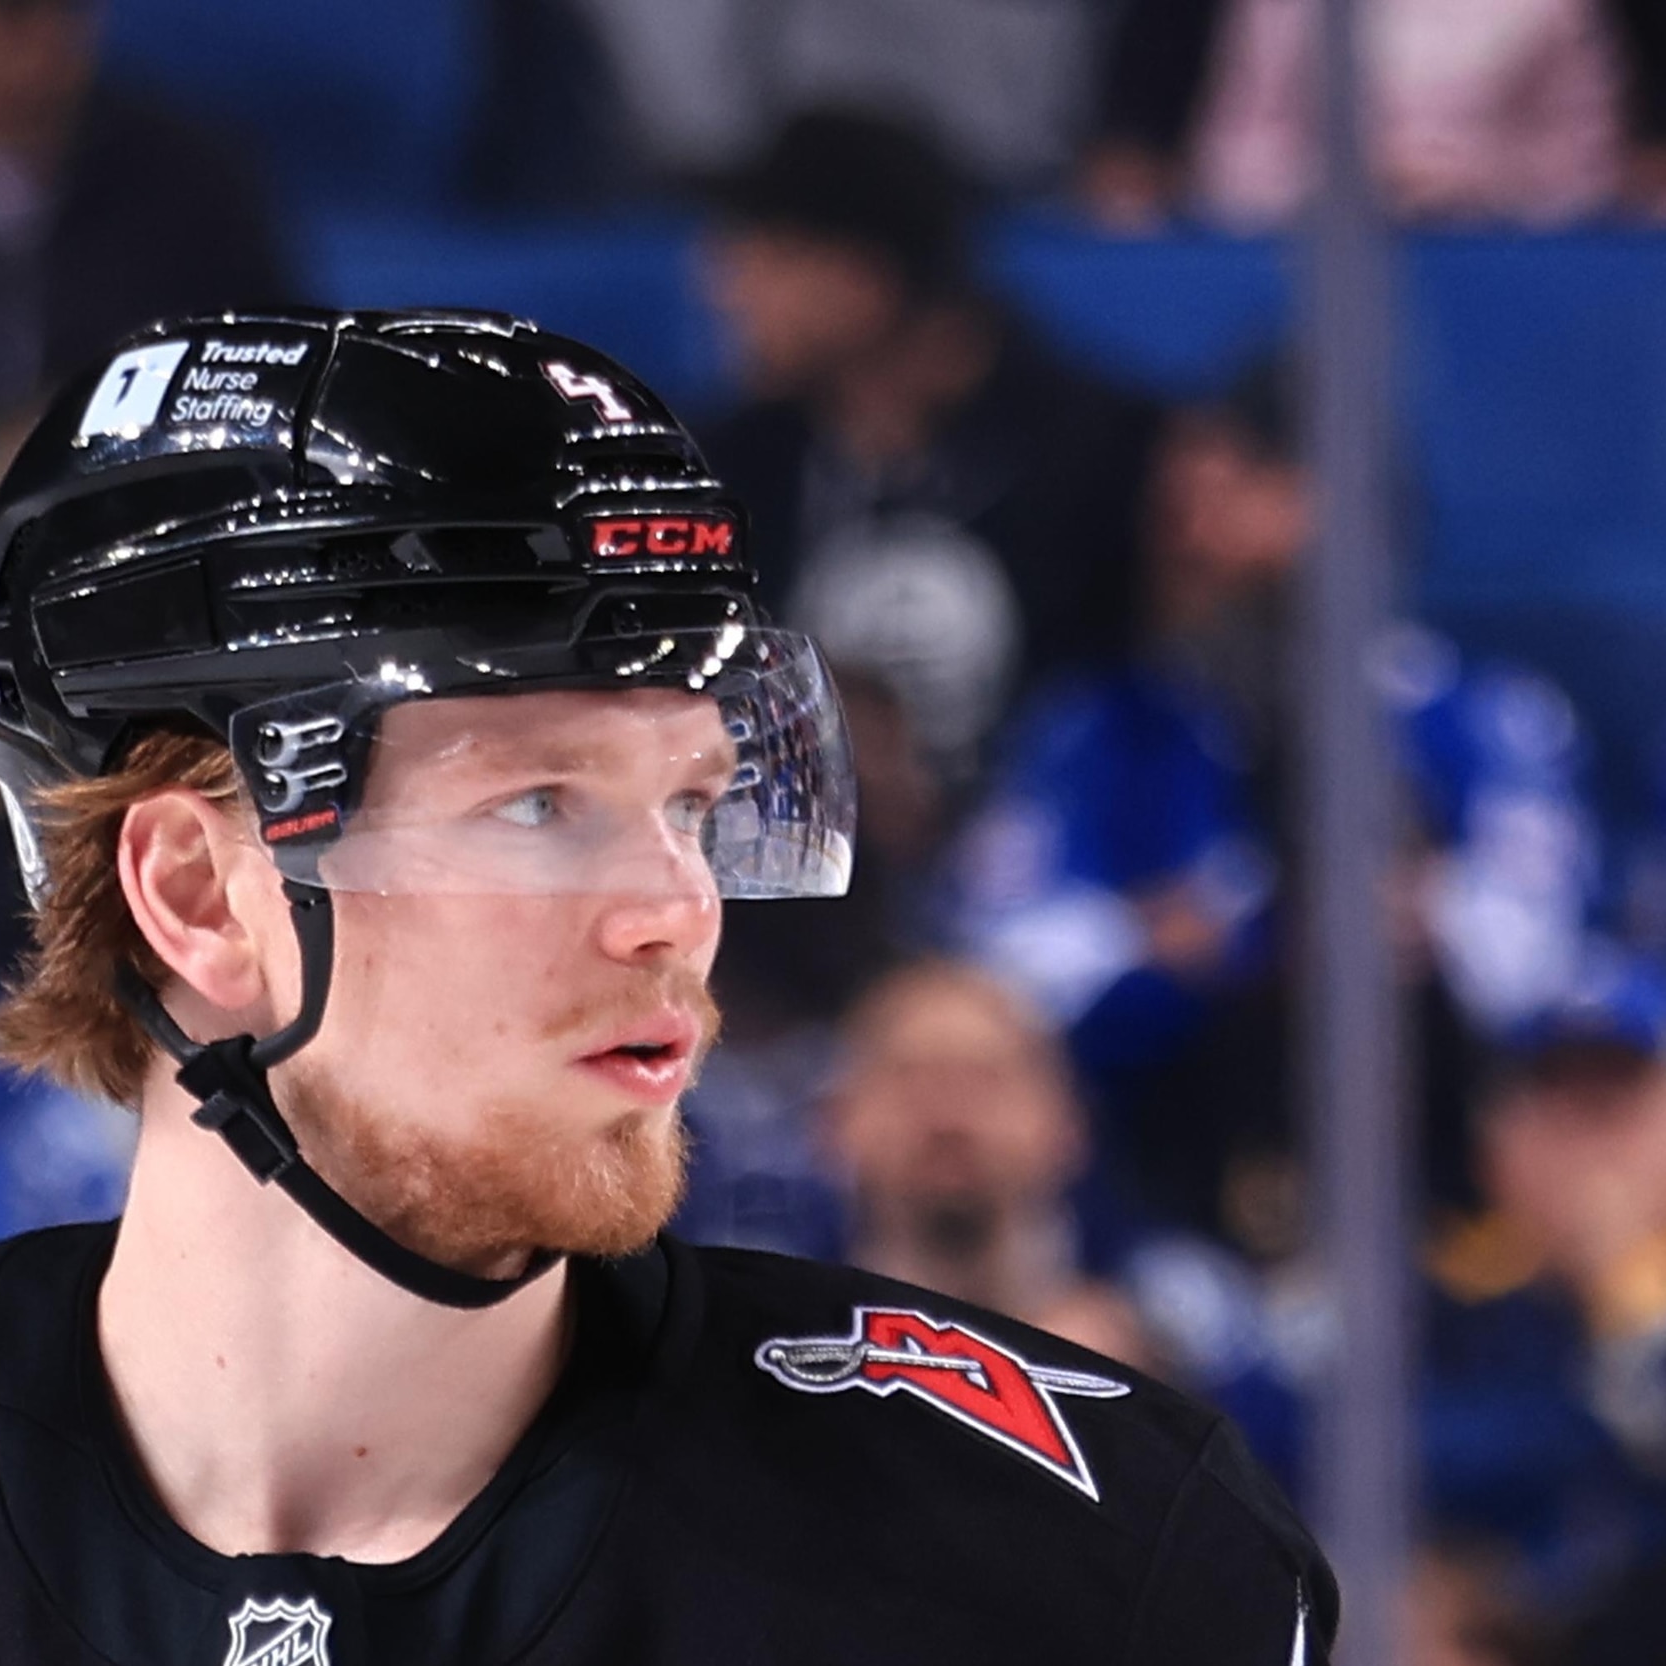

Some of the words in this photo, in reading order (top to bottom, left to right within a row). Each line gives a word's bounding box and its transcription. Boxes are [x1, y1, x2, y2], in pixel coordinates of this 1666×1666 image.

[200, 341, 308, 366] Trusted
[182, 367, 258, 391] Nurse
[539, 361, 635, 425] 4
[171, 394, 275, 427] Staffing
[592, 519, 732, 556] CCM
